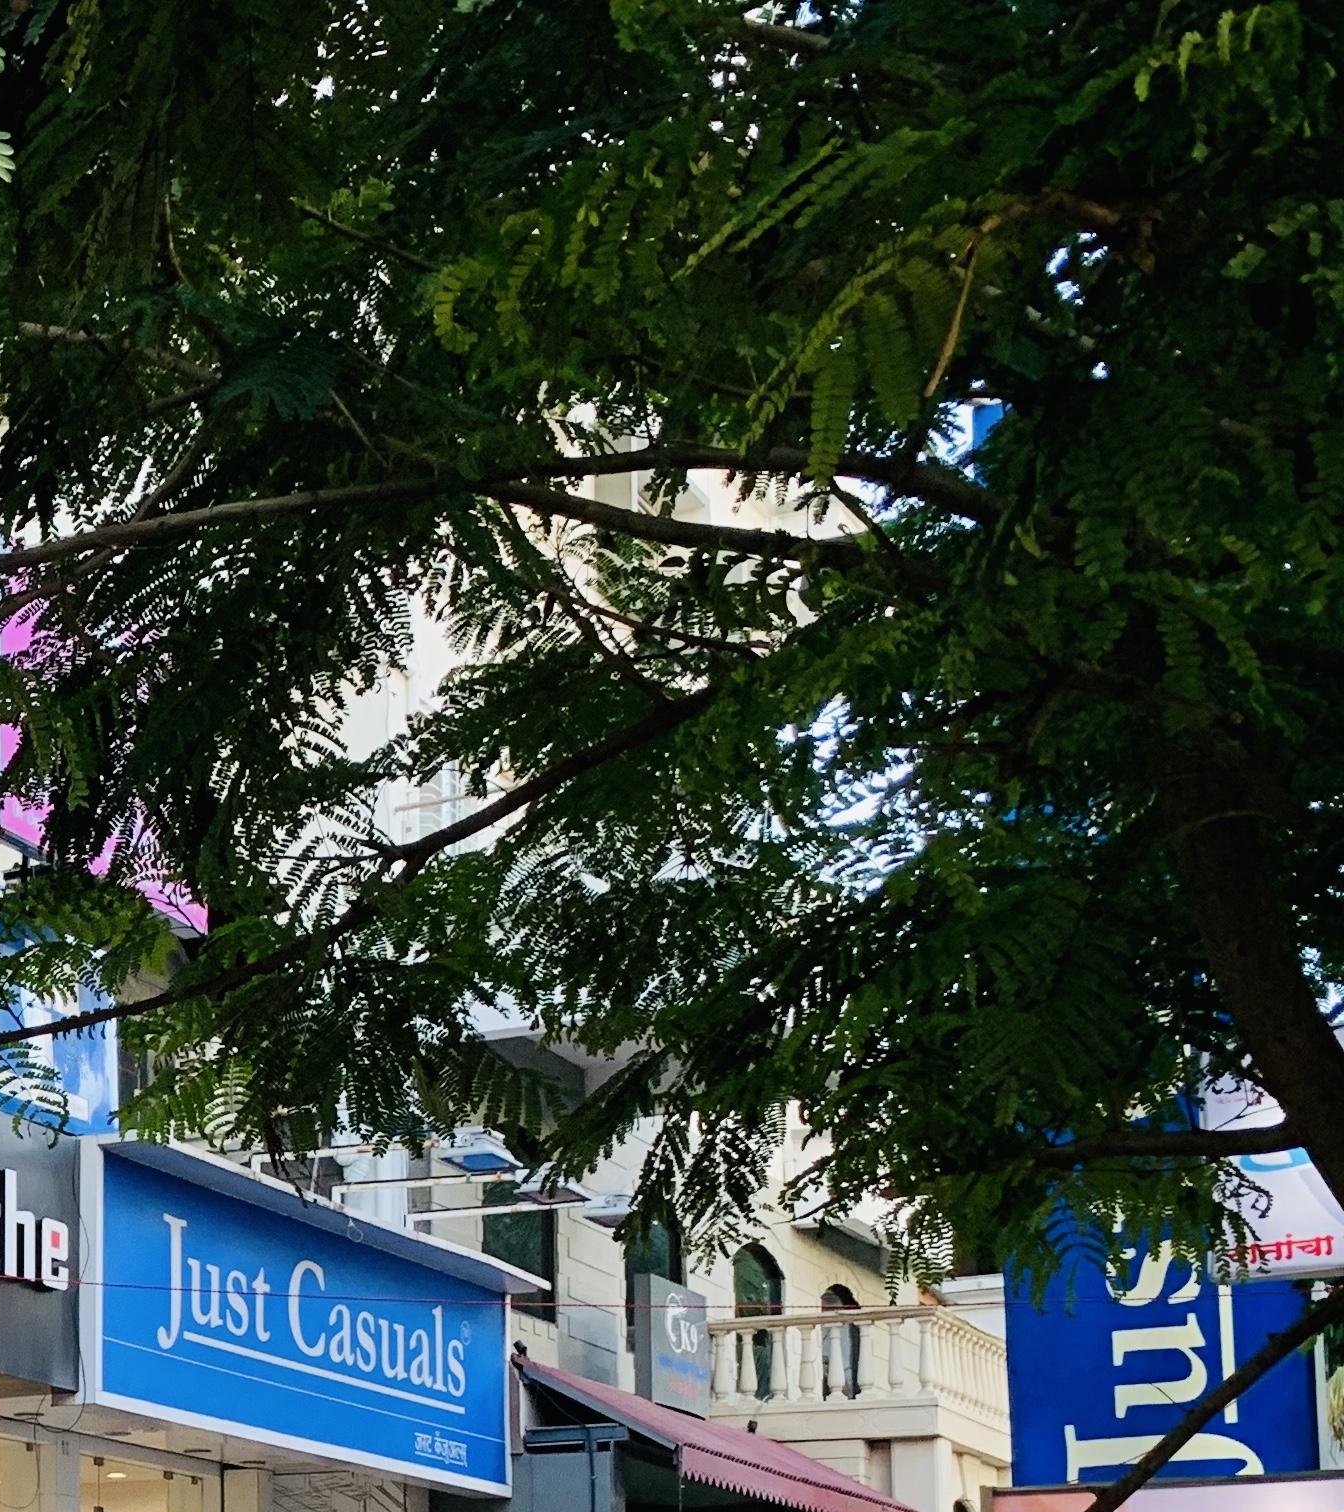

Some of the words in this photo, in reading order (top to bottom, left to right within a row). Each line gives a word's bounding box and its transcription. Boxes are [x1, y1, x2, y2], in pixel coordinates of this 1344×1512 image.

[157, 1213, 271, 1350] Just
[288, 1260, 466, 1397] Casuals
[1064, 1205, 1264, 1485] Jus
